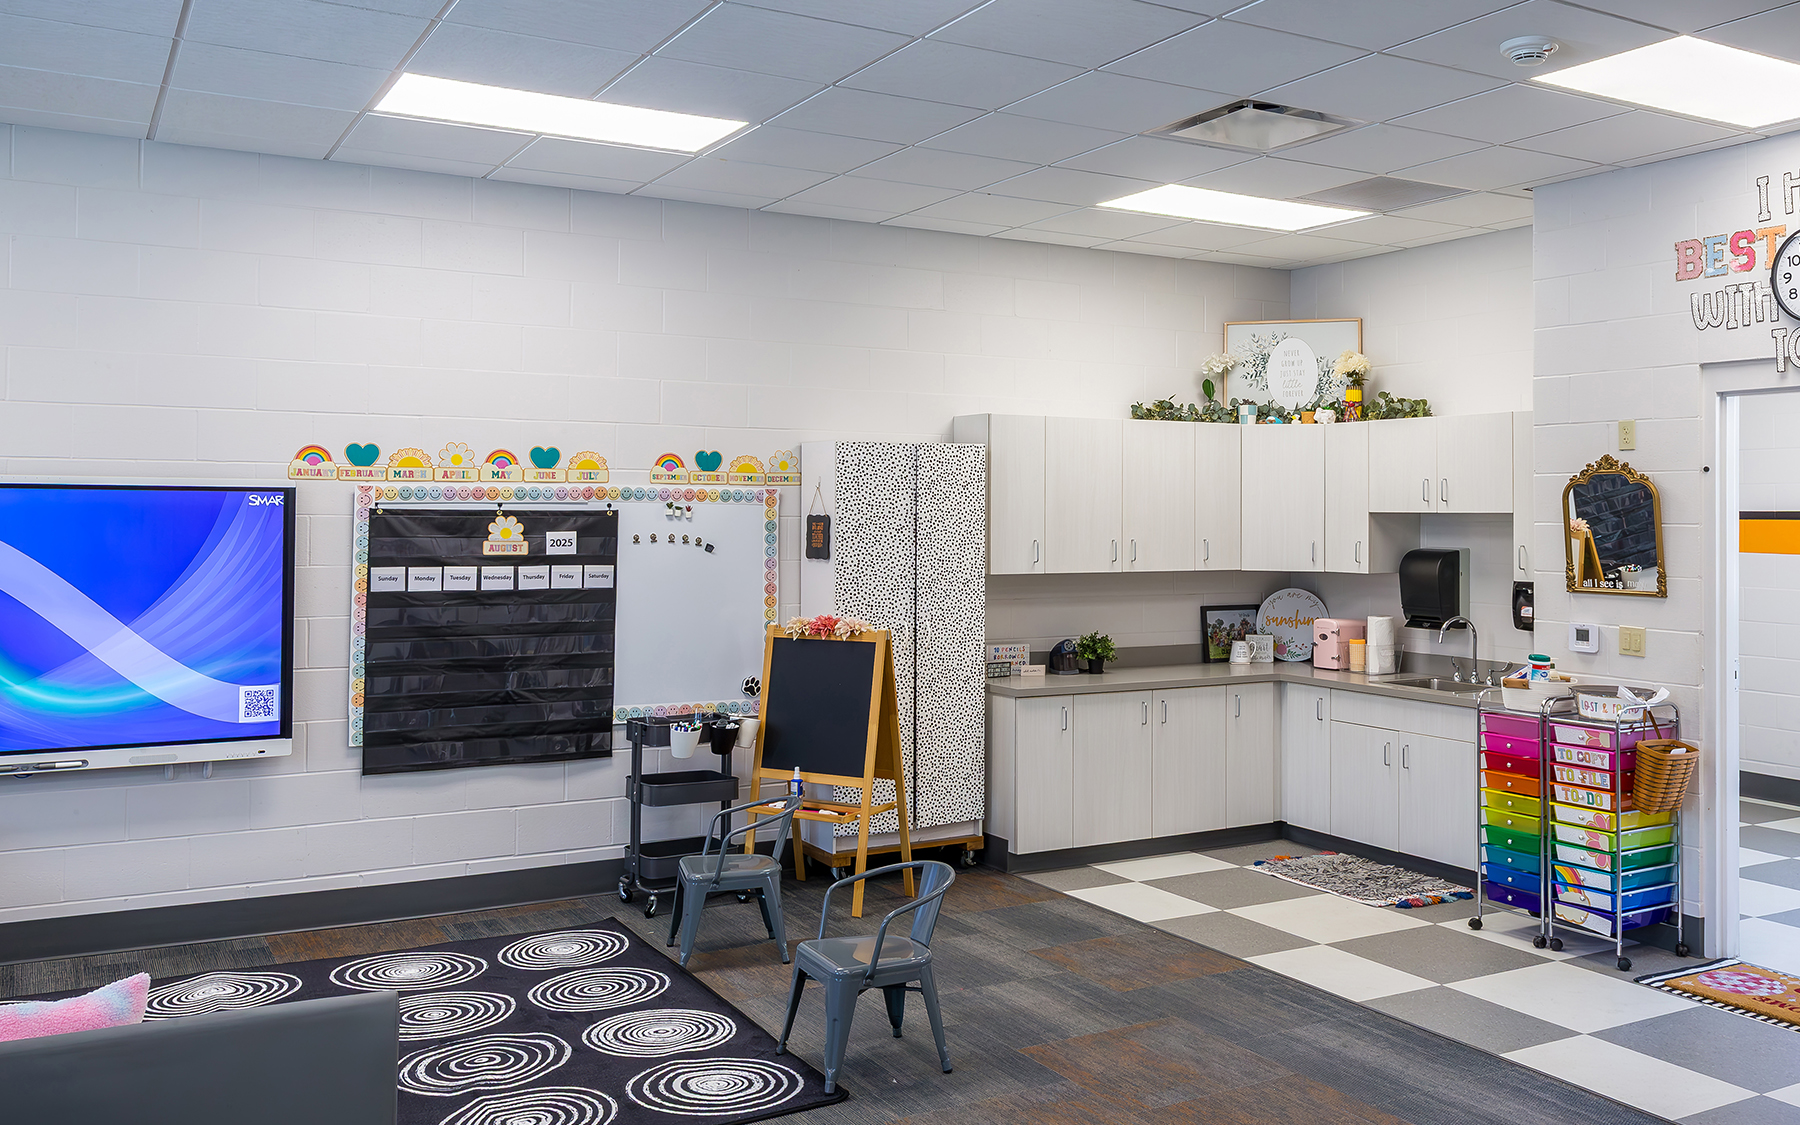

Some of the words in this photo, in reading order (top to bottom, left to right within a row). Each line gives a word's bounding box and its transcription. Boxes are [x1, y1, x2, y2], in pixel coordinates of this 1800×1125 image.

[1756, 175, 1771, 223] I
[1675, 224, 1786, 282] BEST
[1783, 272, 1792, 284] 9
[1789, 288, 1798, 300] 8
[1690, 280, 1779, 330] WITH
[1283, 349, 1300, 357] NEVER
[1280, 370, 1291, 378] JUST
[1294, 369, 1305, 377] STAY
[1282, 379, 1303, 389] little
[290, 468, 335, 477] JANUARY
[340, 469, 385, 477] FEBRUARY
[393, 470, 426, 478] MARCH
[441, 470, 471, 479] APRIL
[491, 471, 512, 479] MAY
[533, 471, 556, 480] JUNE
[576, 471, 599, 480] JULY
[549, 538, 573, 547] 2025
[488, 544, 524, 552] AUGUST
[1582, 579, 1592, 588] all
[1599, 580, 1614, 588] see
[1615, 580, 1624, 589] is
[1268, 595, 1283, 609] you
[1265, 609, 1319, 629] sunshin
[1581, 700, 1598, 712] LOST
[1557, 748, 1573, 760] TO
[1576, 751, 1607, 766] COPY
[1556, 768, 1575, 781] TO
[1578, 770, 1608, 787] FILE
[1562, 788, 1579, 802] TO
[1586, 791, 1603, 807] DO
